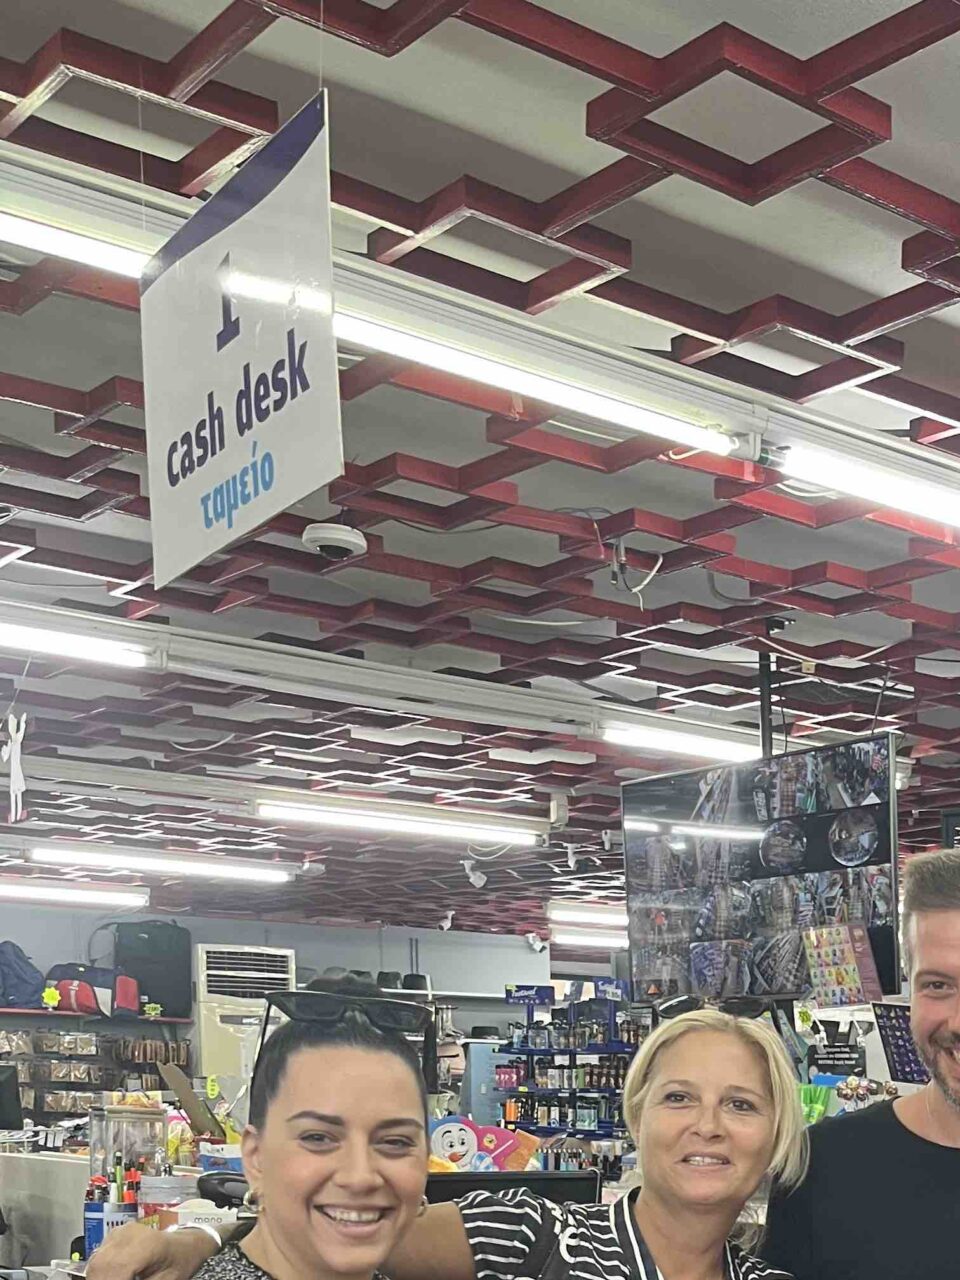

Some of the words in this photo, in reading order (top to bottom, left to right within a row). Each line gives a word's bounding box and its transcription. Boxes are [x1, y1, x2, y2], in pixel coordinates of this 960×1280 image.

[216, 251, 241, 352] 1
[167, 390, 226, 487] cash
[236, 327, 311, 438] desk
[200, 440, 275, 529] ταμείο
[194, 1216, 223, 1224] mono
